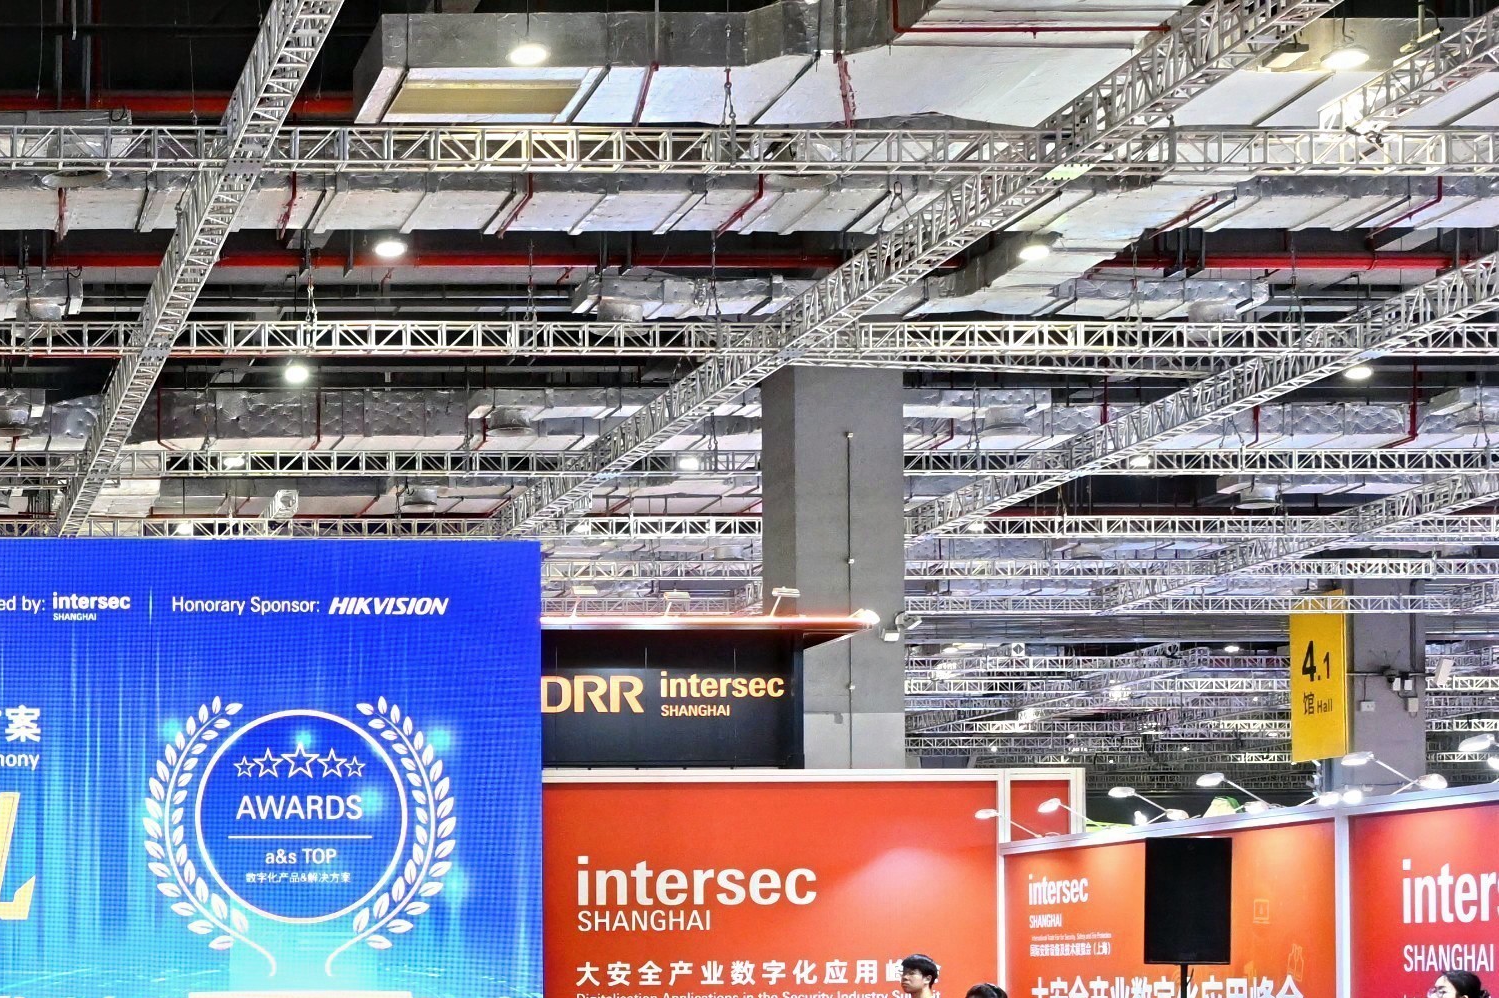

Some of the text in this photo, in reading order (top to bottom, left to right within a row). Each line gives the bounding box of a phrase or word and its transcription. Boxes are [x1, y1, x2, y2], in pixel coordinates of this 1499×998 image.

[22, 595, 46, 614] by:
[52, 592, 131, 610] intersec
[172, 596, 449, 616] Honorary Sponsor: HIKVISION
[53, 613, 97, 621] SHANGHAI
[1302, 640, 1331, 682] 4.1
[541, 675, 645, 713] DRR
[660, 671, 785, 698] intersec
[661, 704, 731, 717] SHANGHAI
[1317, 698, 1333, 714] Hall
[235, 794, 363, 820] AWARDS
[265, 848, 337, 864] a&s TOP
[578, 855, 817, 906] intersec
[1028, 874, 1089, 905] intersec
[1403, 859, 1499, 924] inter
[578, 909, 711, 932] SHANGHAI
[1029, 913, 1062, 928] SHANGHAI
[1403, 943, 1495, 973] SHANGHAI
[576, 959, 941, 987] 大安全产业数字化应用峰
